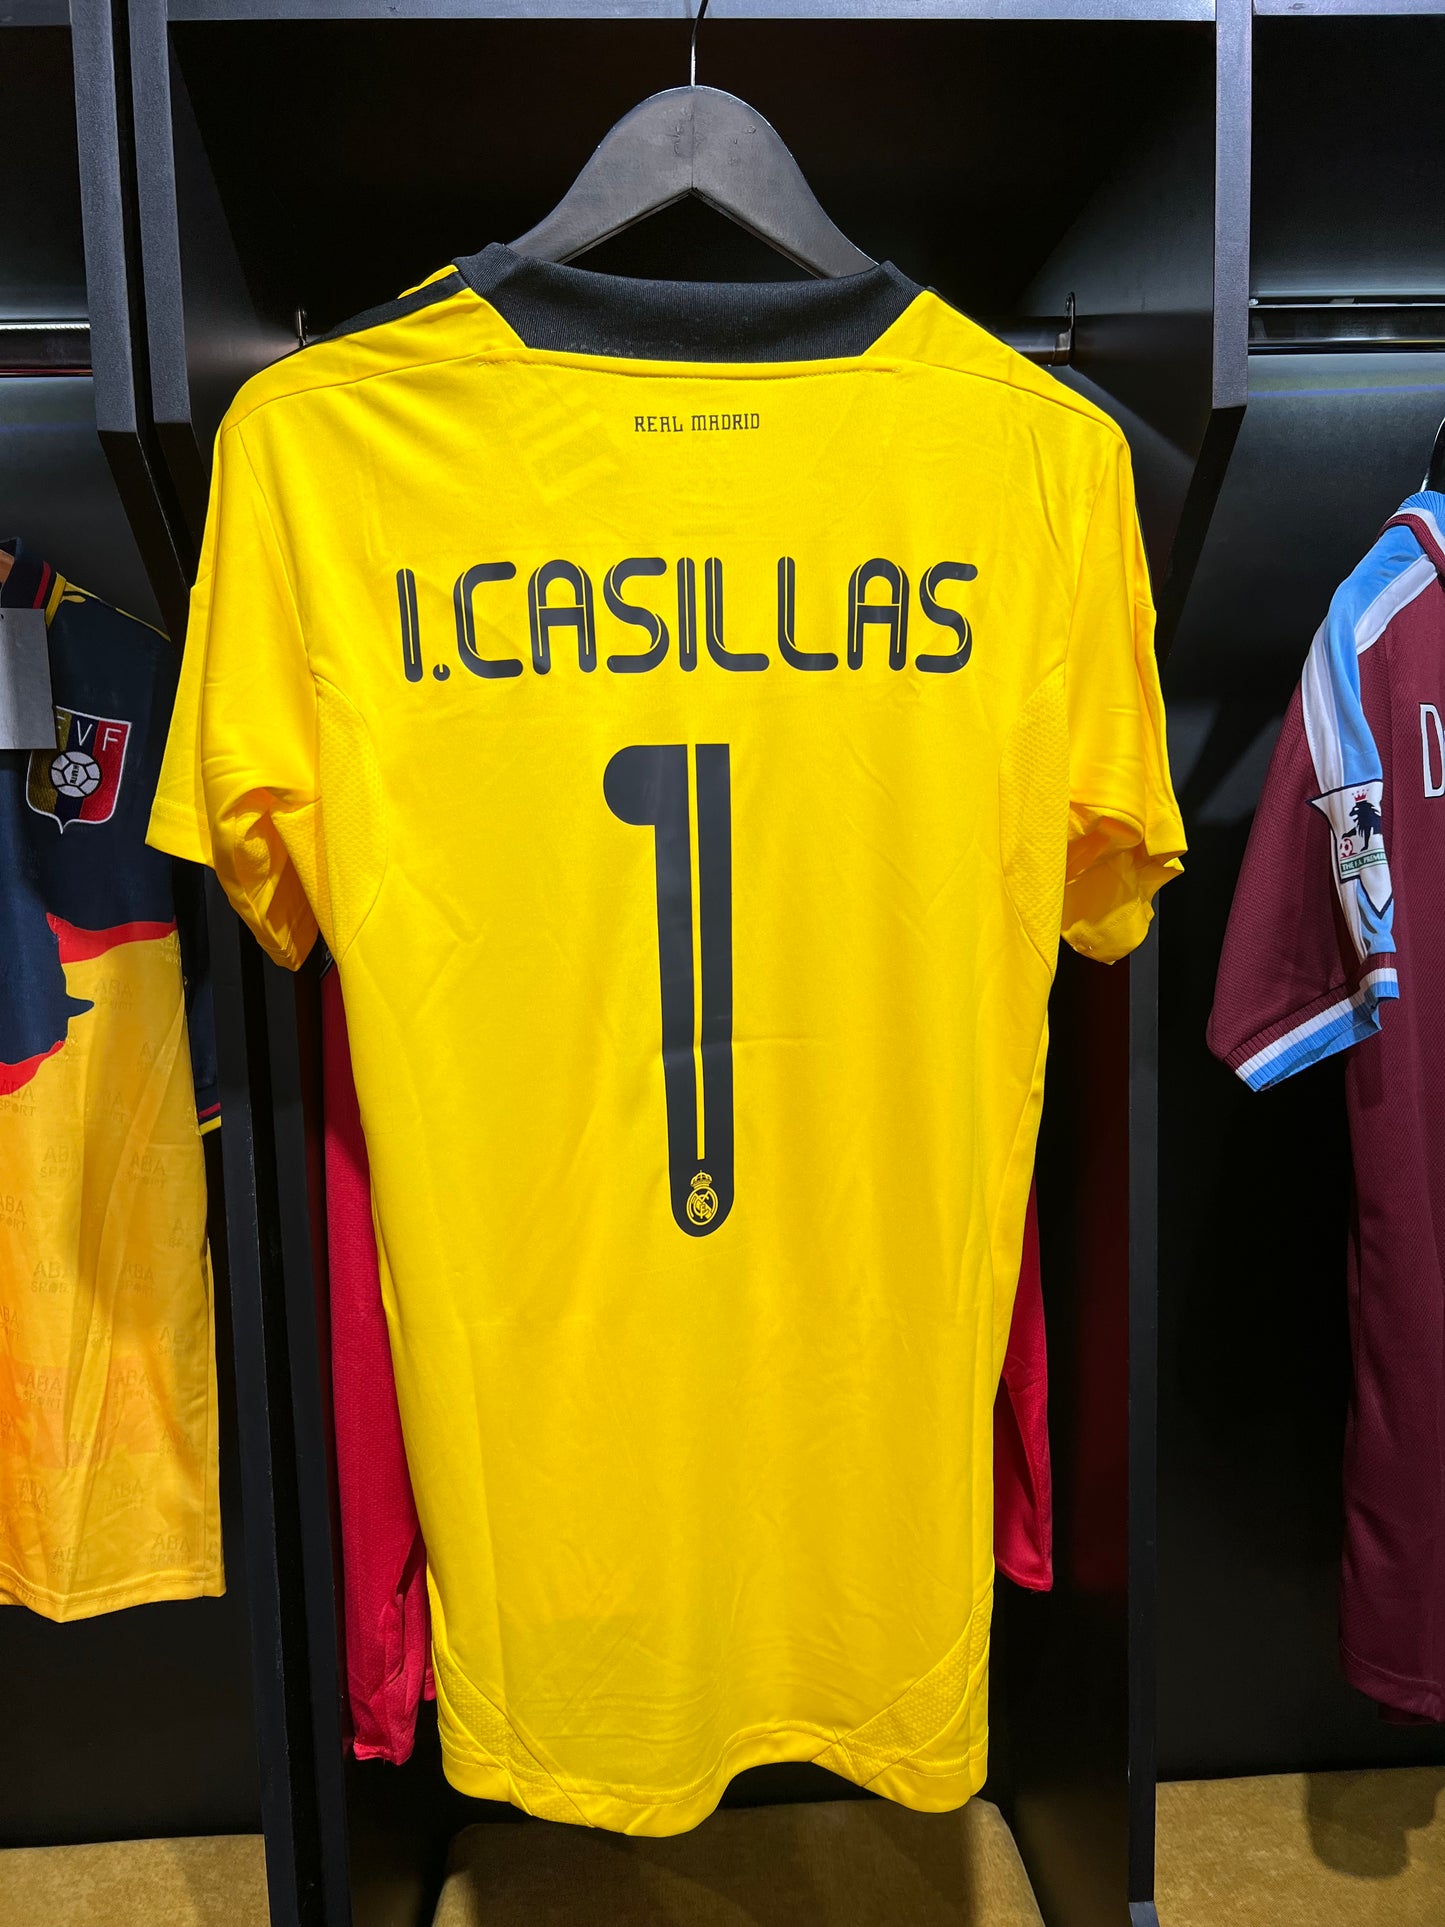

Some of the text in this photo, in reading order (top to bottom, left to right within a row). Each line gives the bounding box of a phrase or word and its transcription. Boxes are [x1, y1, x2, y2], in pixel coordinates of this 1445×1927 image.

[634, 413, 760, 433] REAL MADRID
[396, 556, 978, 683] I.CASILLAS
[1342, 862, 1355, 871] THE
[603, 743, 735, 1238] 1
